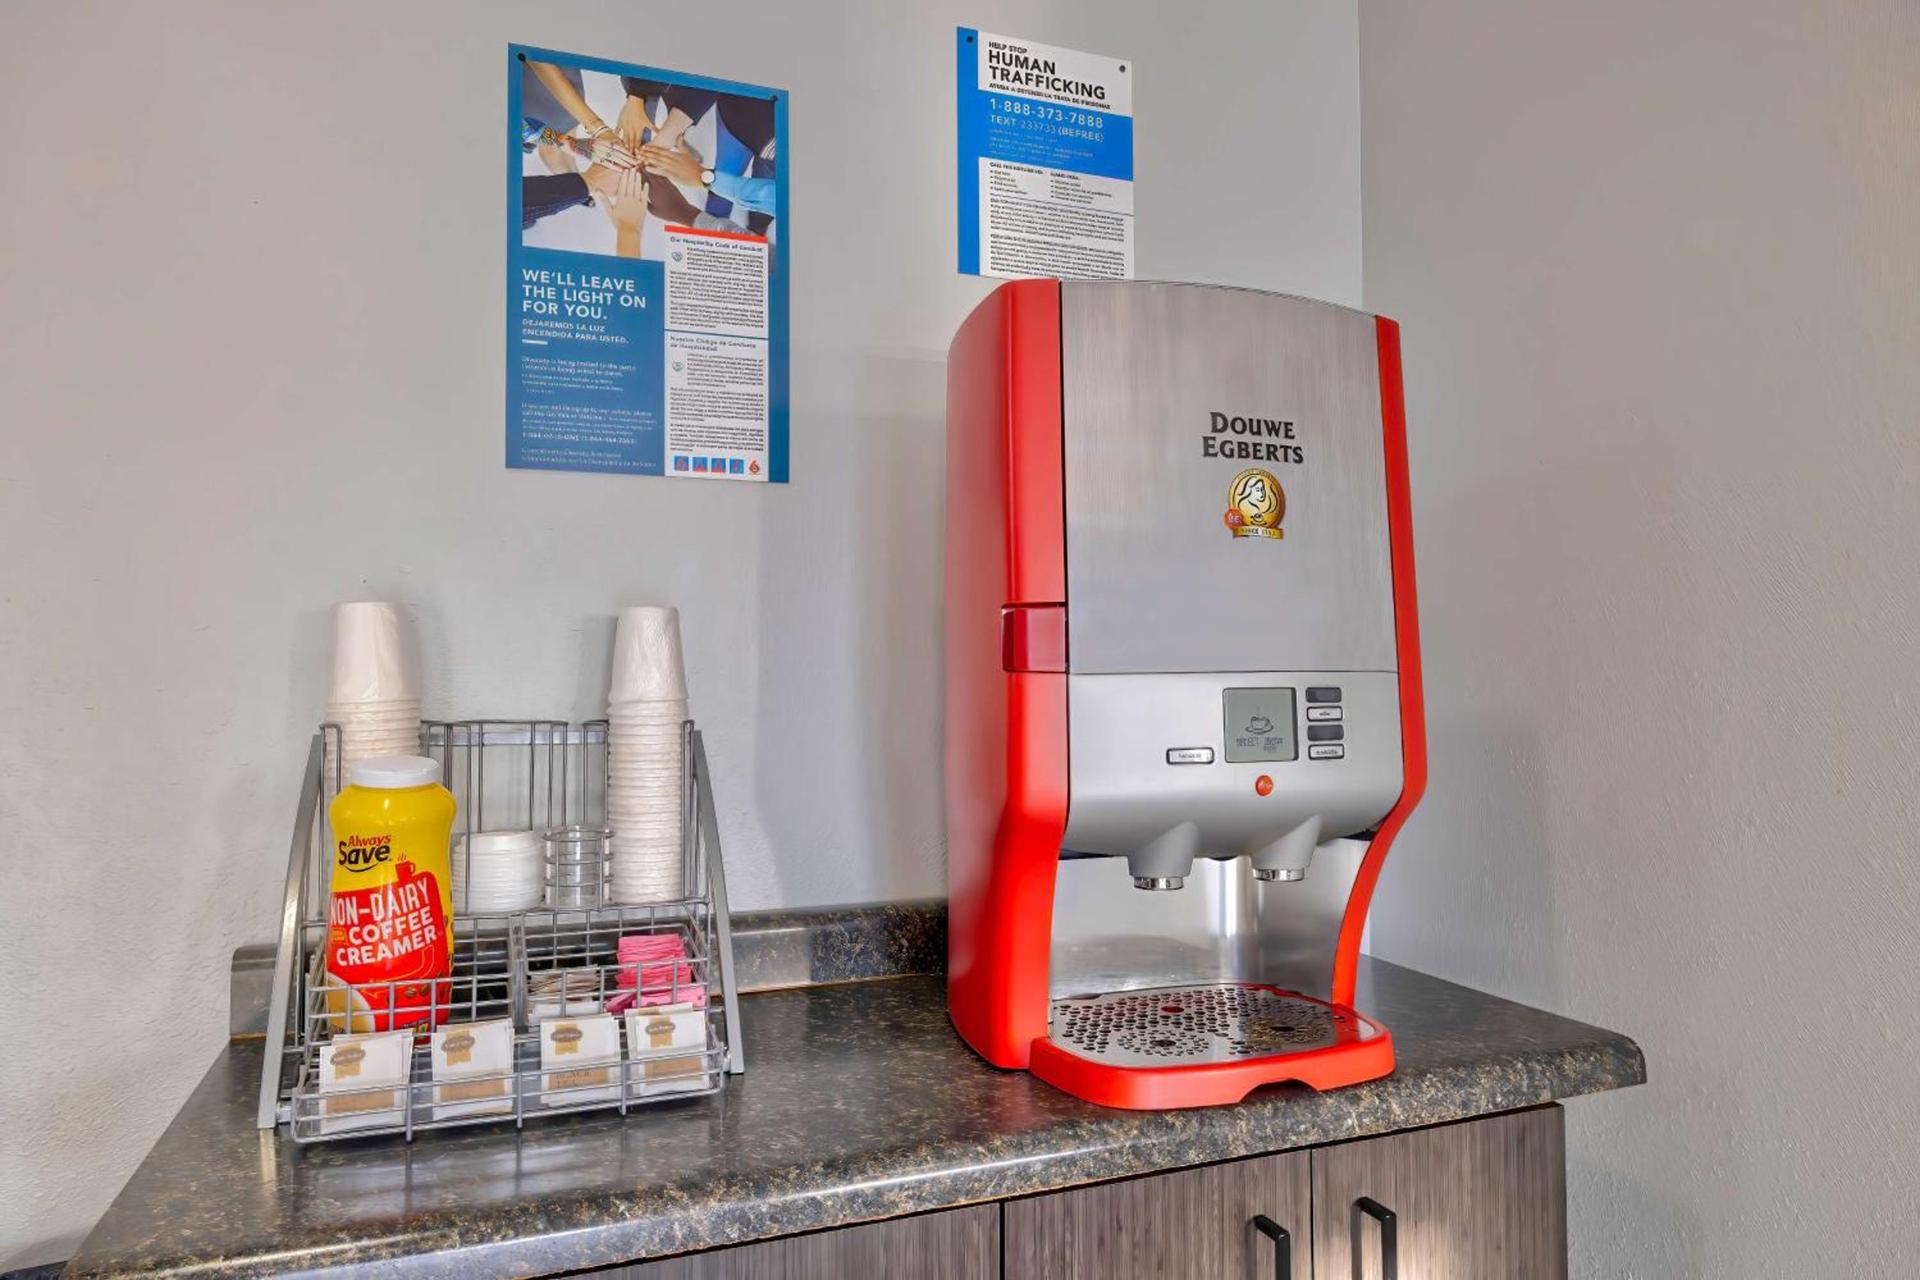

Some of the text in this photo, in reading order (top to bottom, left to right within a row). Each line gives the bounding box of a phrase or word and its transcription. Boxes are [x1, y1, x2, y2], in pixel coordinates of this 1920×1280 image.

[989, 41, 1028, 54] HELP STOP
[989, 49, 1056, 75] HUMAN
[989, 65, 1106, 100] TRAFFICKING
[990, 98, 1104, 129] 1-888-373-7888
[991, 114, 1017, 126] TEXT
[715, 241, 730, 249] Code
[522, 268, 635, 292] WE'LL LEAVE
[522, 284, 647, 309] THE LIGHT ON
[522, 300, 608, 321] FOR YOU.
[522, 318, 606, 333] DEJAREMOS LA LUZ
[522, 328, 630, 345] ENCENDIDA PARA USTED.
[1210, 411, 1296, 440] DOUWE
[1202, 436, 1304, 465] EGBERTS
[338, 840, 391, 866] Save
[348, 834, 392, 847] Always
[330, 877, 430, 926] NON-DAIRY
[348, 905, 433, 946] COFFEE
[336, 925, 437, 967] CREAMER
